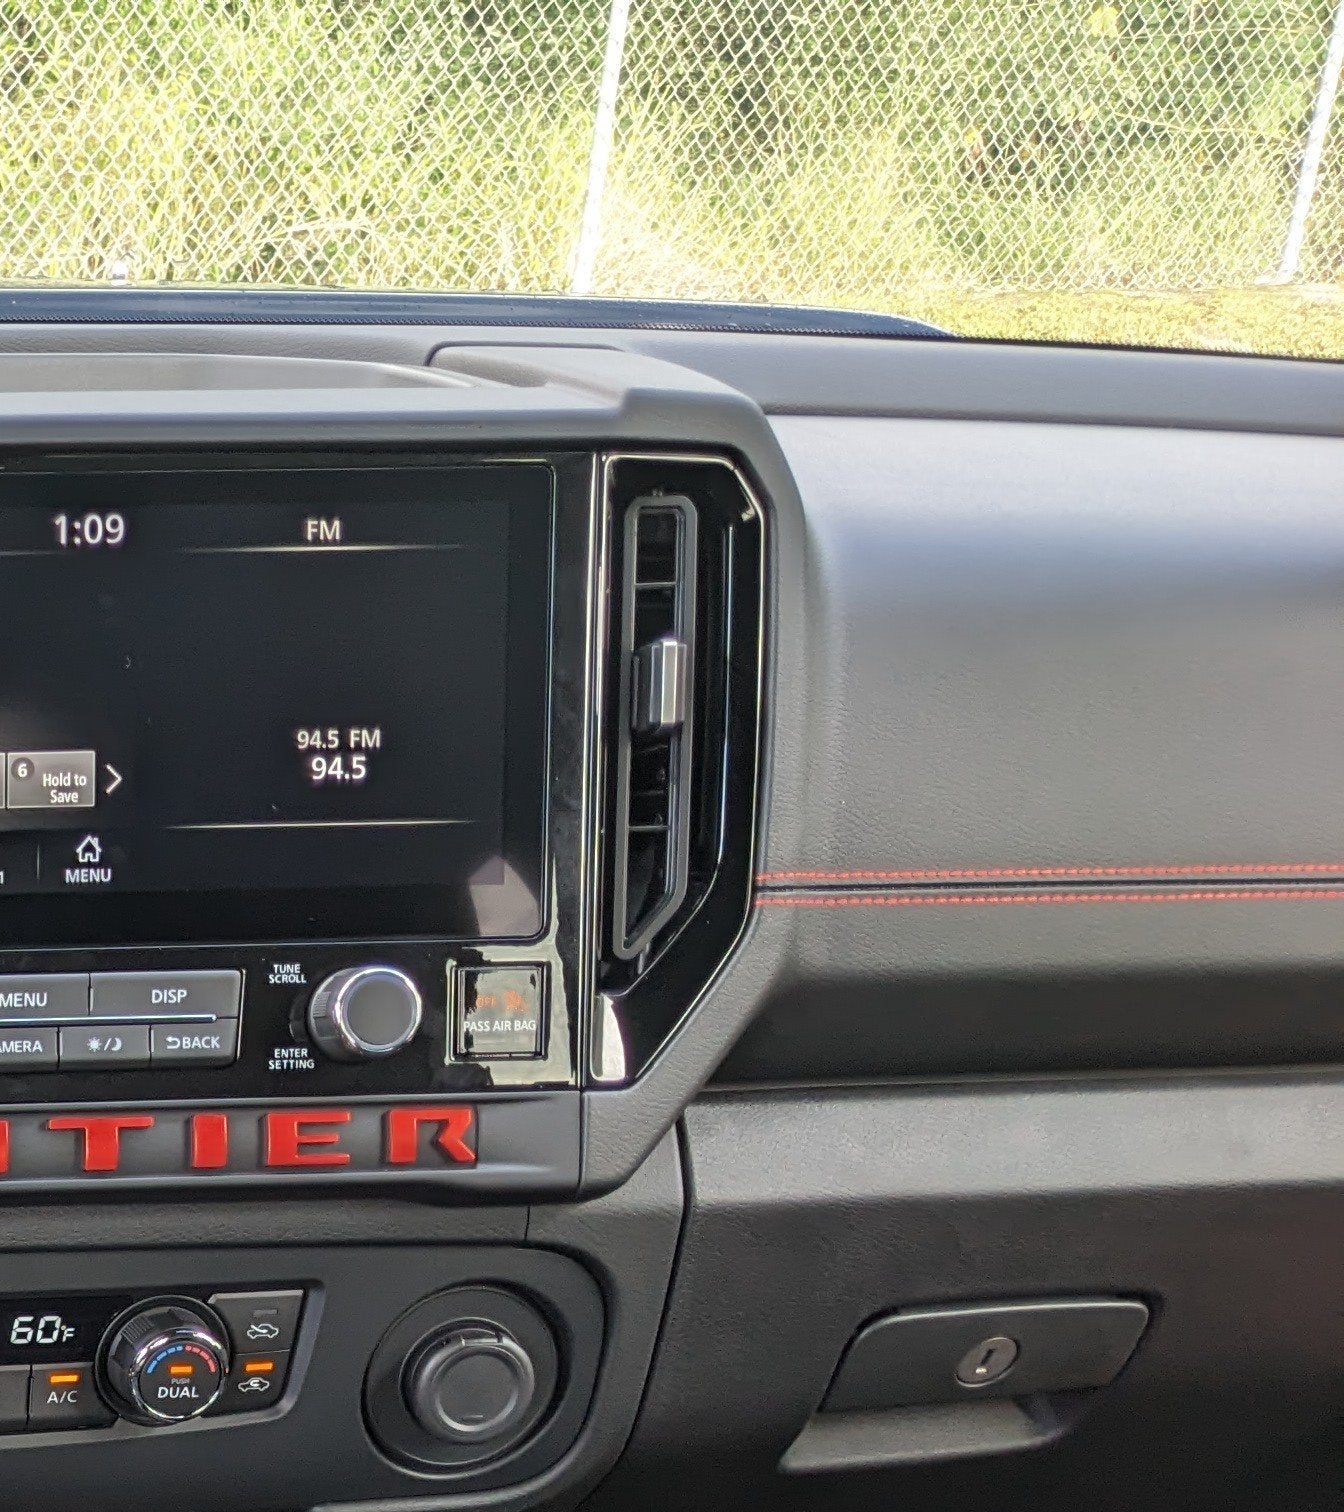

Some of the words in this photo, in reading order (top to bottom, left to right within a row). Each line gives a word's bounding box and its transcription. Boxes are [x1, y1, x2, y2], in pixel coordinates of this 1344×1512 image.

[54, 513, 126, 545] 1:09
[306, 518, 342, 542] FM
[296, 729, 339, 750] 94.5
[350, 728, 382, 749] FM
[17, 763, 27, 778] 6
[310, 755, 368, 781] 94.5
[42, 773, 72, 787] Hold
[74, 774, 87, 787] to
[50, 790, 78, 804] Save
[65, 869, 112, 883] MENU
[273, 964, 301, 975] TUNE
[268, 973, 307, 985] SCROLL
[151, 988, 188, 1004] DISP
[463, 1021, 490, 1032] PASS
[493, 1020, 512, 1031] AIR
[514, 1020, 536, 1031] BAG
[181, 1034, 221, 1051] BACK
[274, 1048, 309, 1059] ENTER
[268, 1058, 315, 1070] SETTING
[170, 1377, 191, 1385] PUSH
[47, 1390, 78, 1405] A/C
[157, 1385, 199, 1400] DUAL
